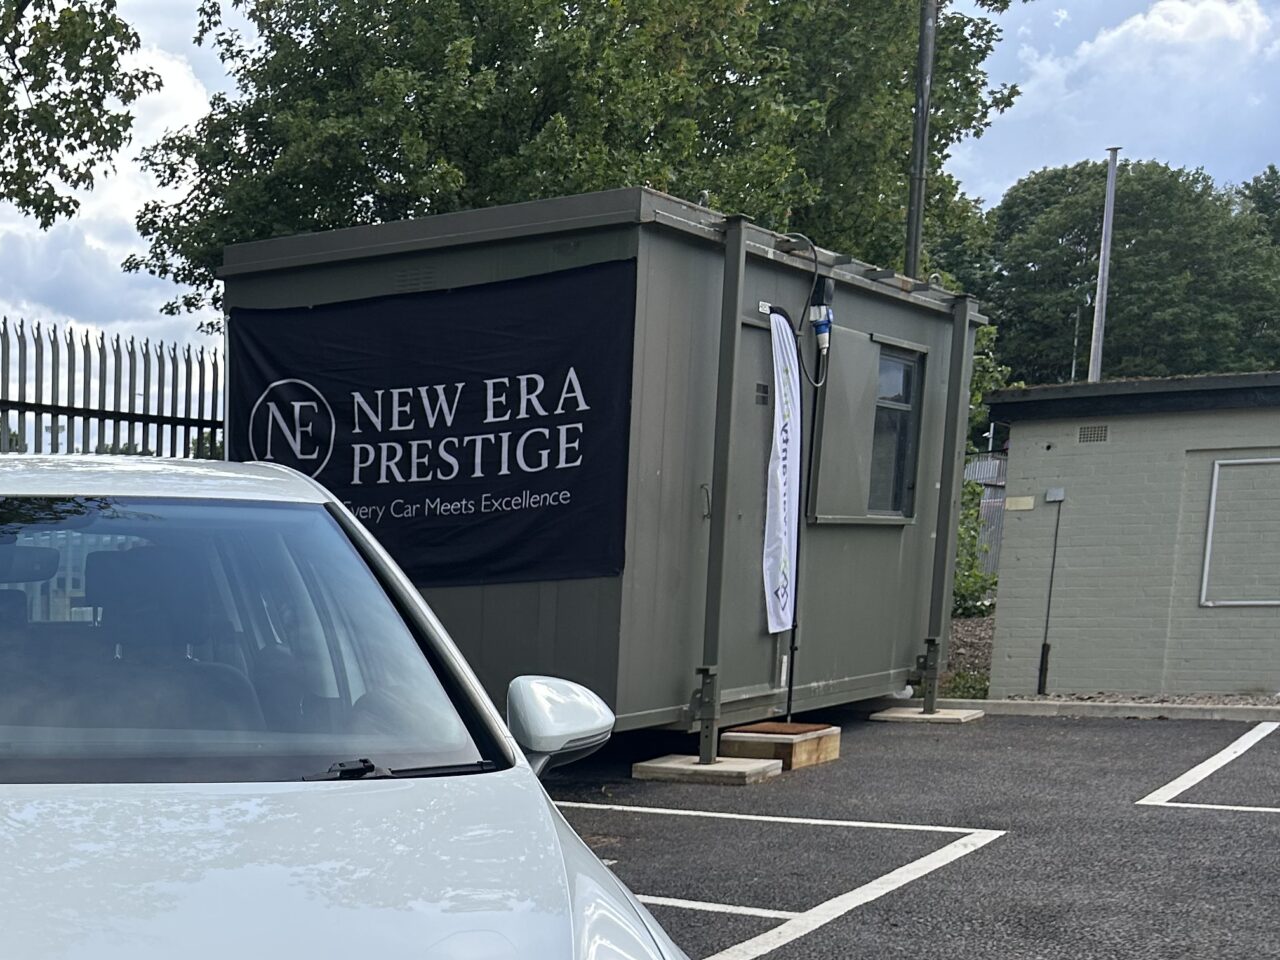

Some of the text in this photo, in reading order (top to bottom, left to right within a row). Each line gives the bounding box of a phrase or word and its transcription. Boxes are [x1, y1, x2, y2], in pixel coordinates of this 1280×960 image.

[263, 400, 320, 461] NE
[351, 366, 591, 434] NEW ERA
[351, 422, 584, 485] PRESTIGE
[343, 489, 571, 524] very Car Meets Excellence
